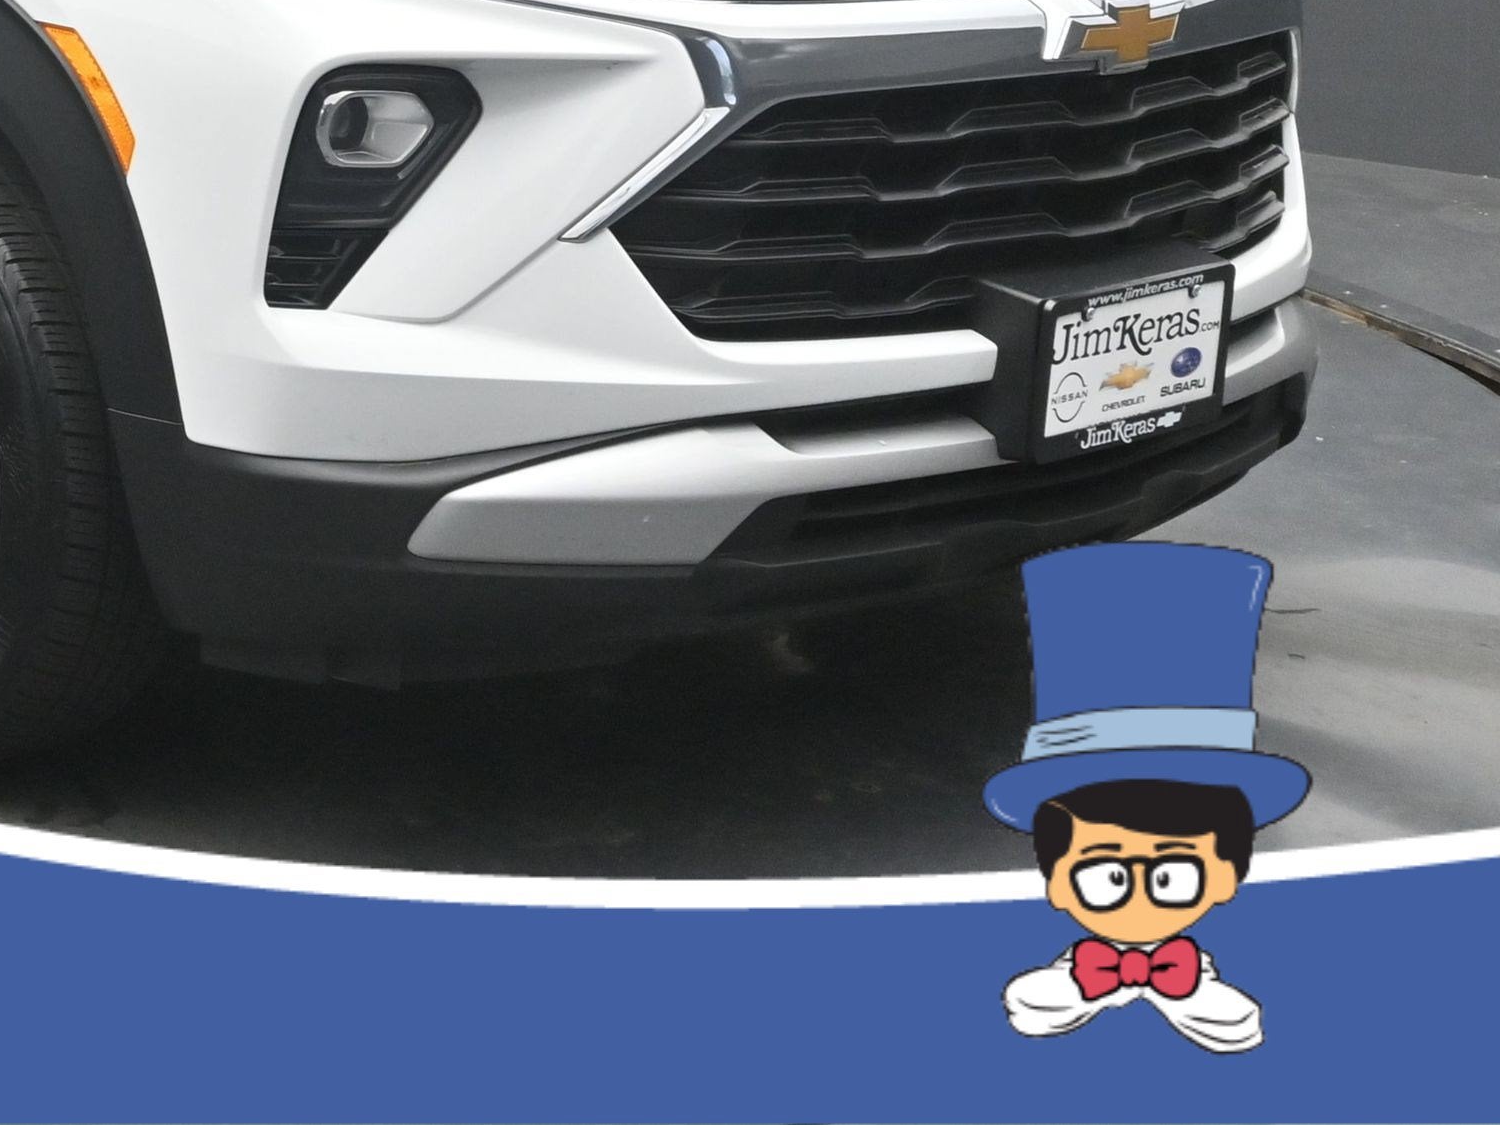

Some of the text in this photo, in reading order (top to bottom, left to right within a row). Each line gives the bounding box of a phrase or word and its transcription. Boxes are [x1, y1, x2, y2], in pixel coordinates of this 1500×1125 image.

[1087, 273, 1204, 307] www.jimkeras.com
[1160, 377, 1206, 398] SUBARU
[1051, 389, 1089, 406] NISSAN
[1101, 395, 1147, 413] CHEVROLET
